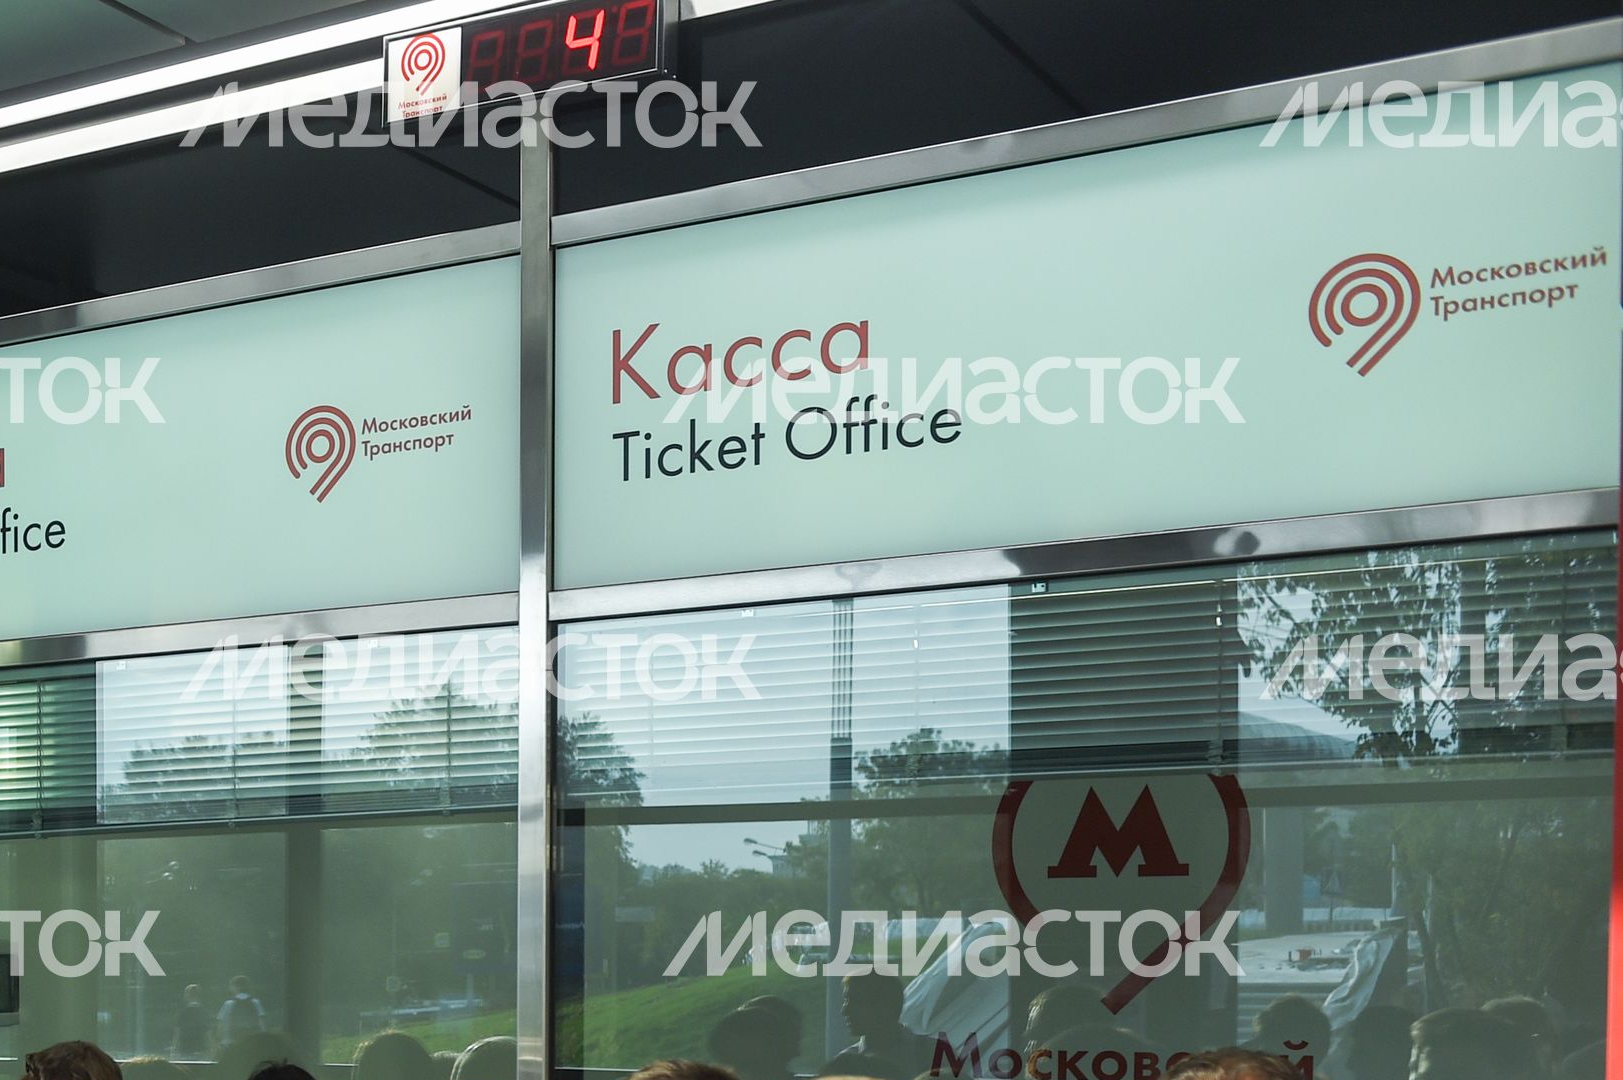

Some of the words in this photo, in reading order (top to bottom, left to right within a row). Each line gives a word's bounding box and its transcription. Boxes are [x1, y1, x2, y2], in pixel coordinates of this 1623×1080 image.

[564, 9, 605, 71] 4
[1430, 246, 1608, 289] Московский
[1430, 283, 1579, 322] Транспорт
[612, 320, 869, 405] Касса
[361, 405, 472, 435] Московский
[612, 418, 766, 482] Ticket
[785, 394, 962, 461] Office
[361, 434, 454, 461] Транспорт
